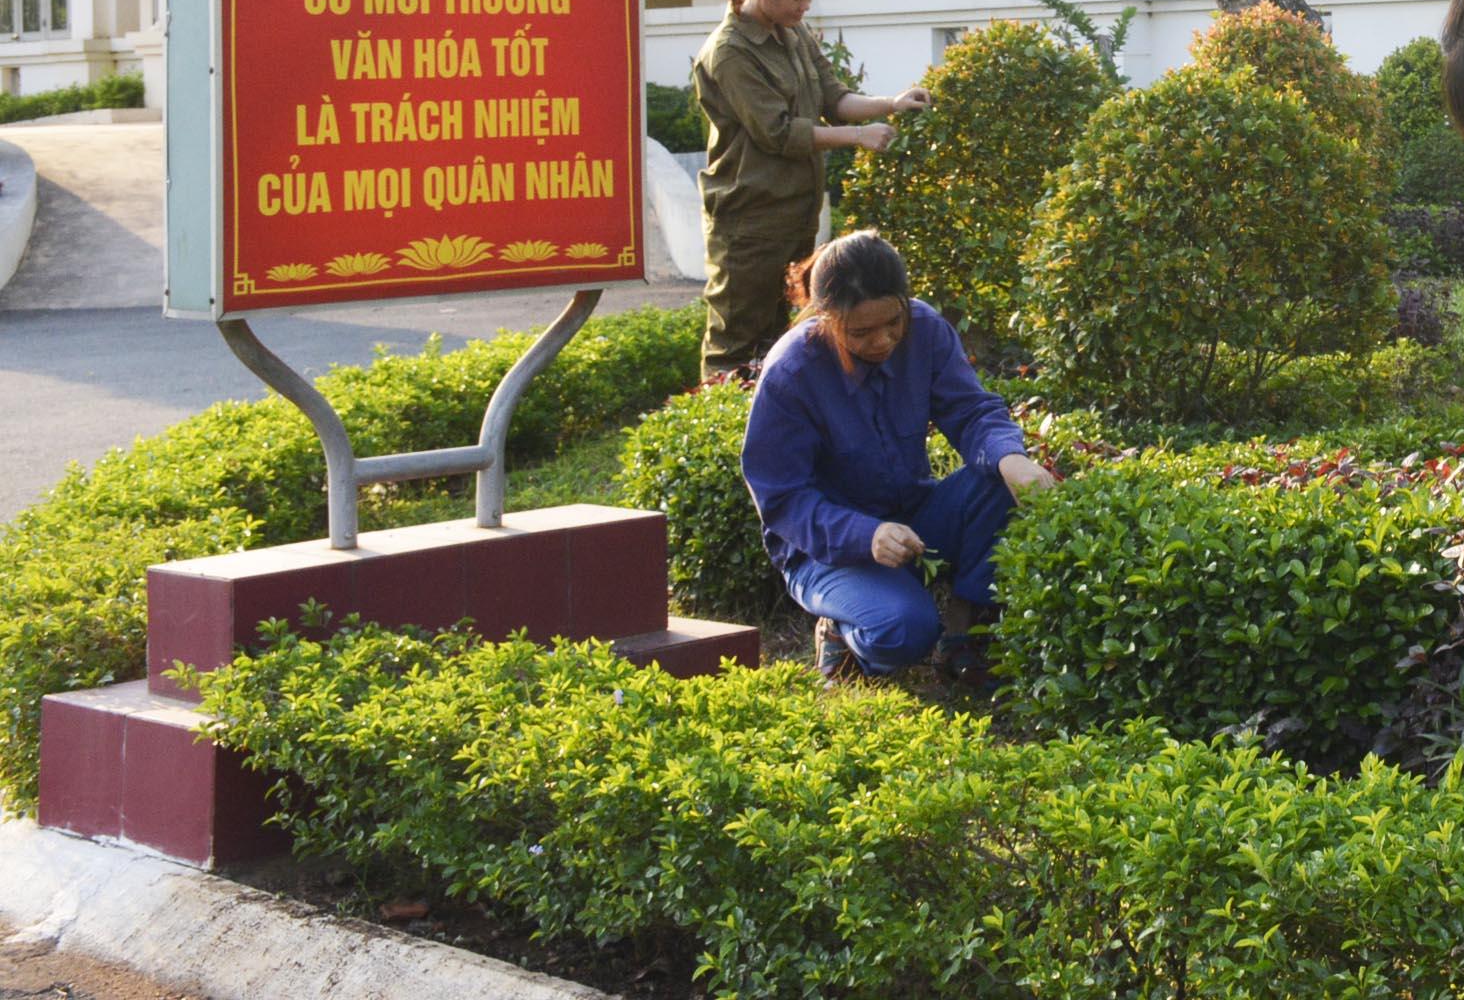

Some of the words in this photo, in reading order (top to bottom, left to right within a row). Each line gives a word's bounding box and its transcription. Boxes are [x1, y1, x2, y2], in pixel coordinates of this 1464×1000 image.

[331, 31, 402, 80] VĂN
[414, 30, 482, 78] HÓA
[492, 24, 548, 76] TỐT
[297, 95, 340, 145] LÀ
[351, 93, 462, 143] TRÁCH
[474, 90, 579, 145] NHIỆM
[259, 155, 331, 215] CỦA
[344, 168, 410, 217] MỌI
[424, 156, 514, 210] QUÂN
[526, 152, 613, 200] NHÂN
